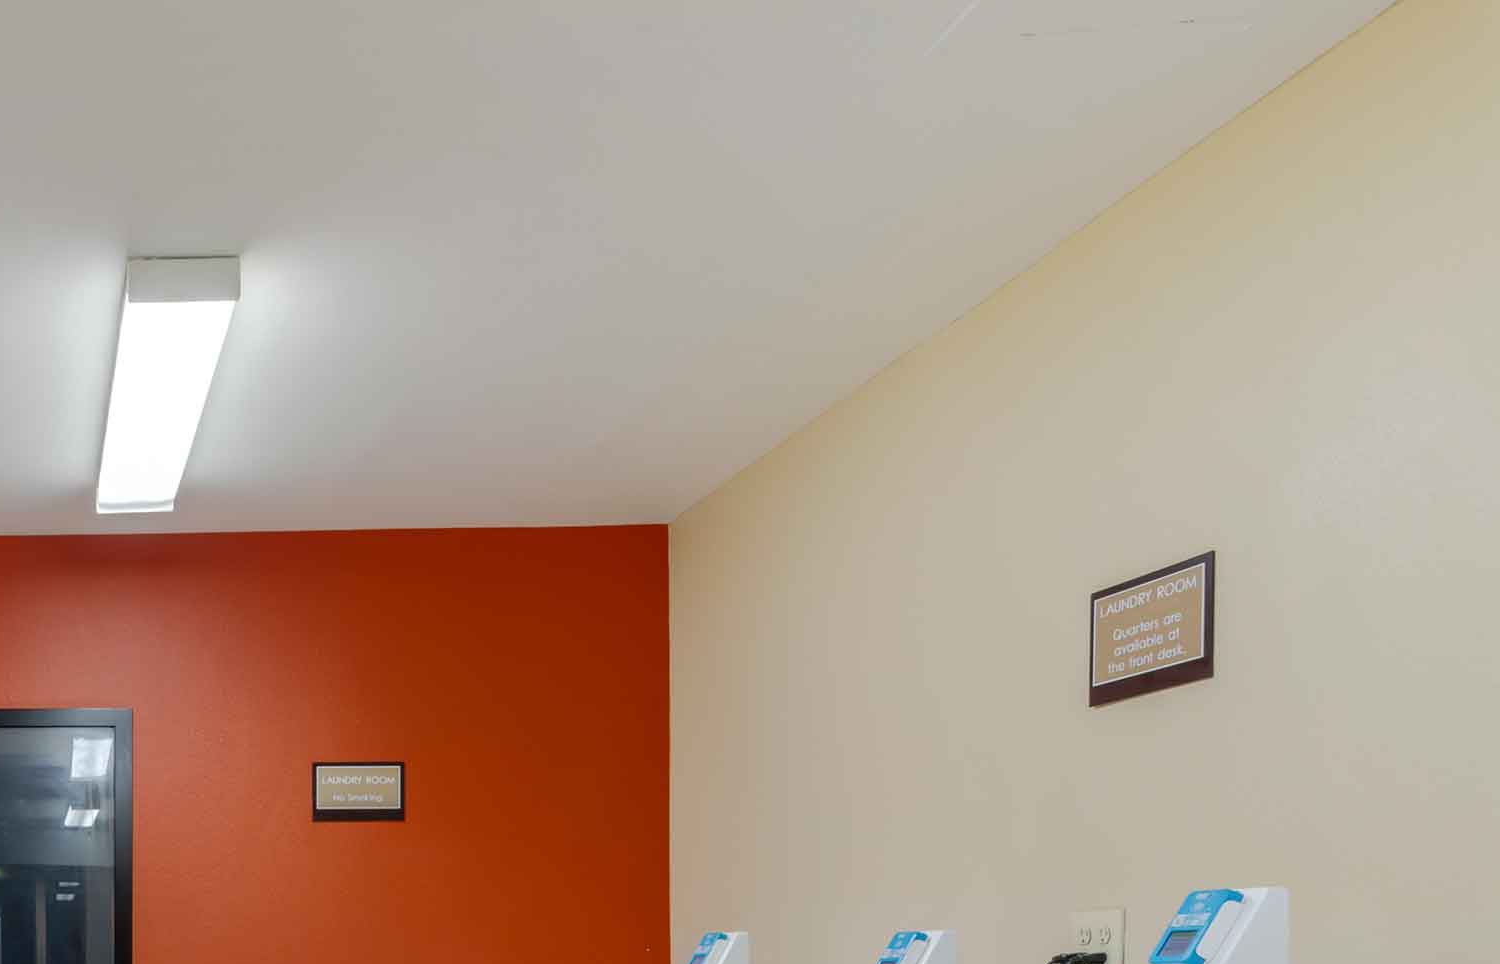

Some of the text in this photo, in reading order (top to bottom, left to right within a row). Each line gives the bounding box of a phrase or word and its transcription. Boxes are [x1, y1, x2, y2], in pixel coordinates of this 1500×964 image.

[1099, 575, 1197, 618] LAUNDRY ROOM
[1113, 611, 1182, 641] Quarters are
[1113, 629, 1180, 657] available at
[1108, 660, 1125, 674] the
[1129, 652, 1154, 669] front
[322, 775, 396, 785] LAUNDRY ROOM
